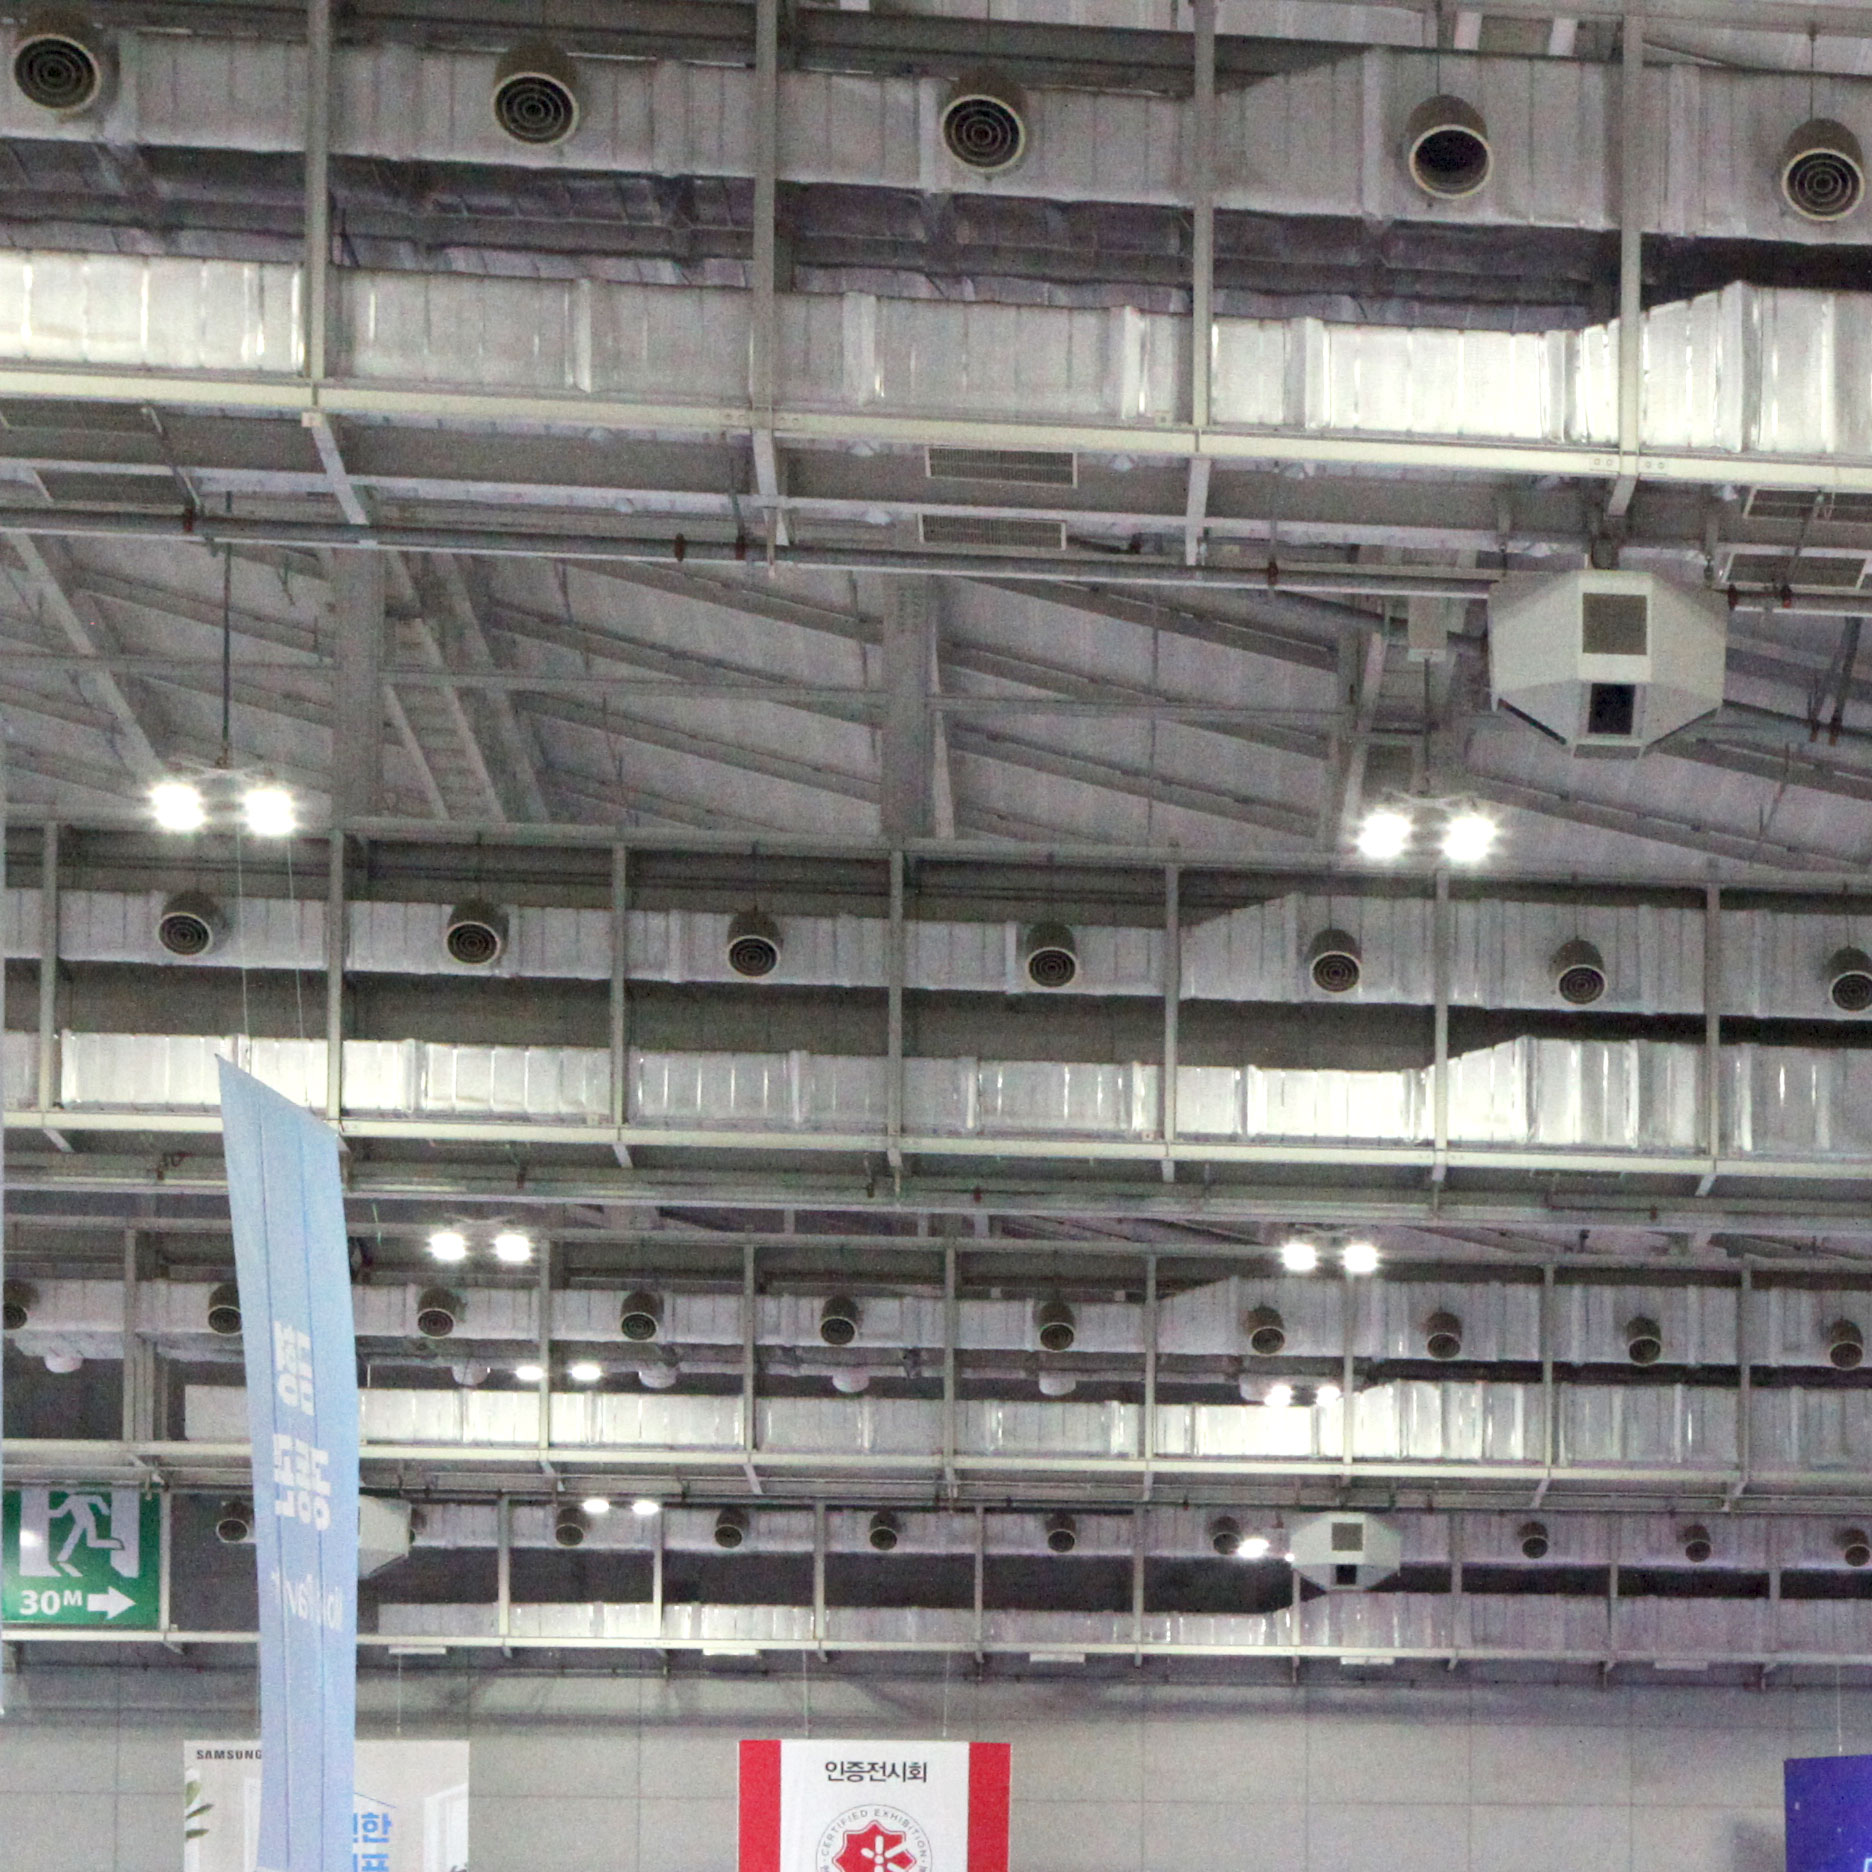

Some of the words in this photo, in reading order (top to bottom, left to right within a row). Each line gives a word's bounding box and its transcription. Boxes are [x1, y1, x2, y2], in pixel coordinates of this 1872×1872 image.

[19, 1589, 83, 1616] 30M
[196, 1749, 262, 1760] SAMSUNG
[825, 1760, 928, 1784] 인증전시회
[821, 1808, 868, 1857] CERTIFIED
[874, 1807, 927, 1858] EXHIBITION
